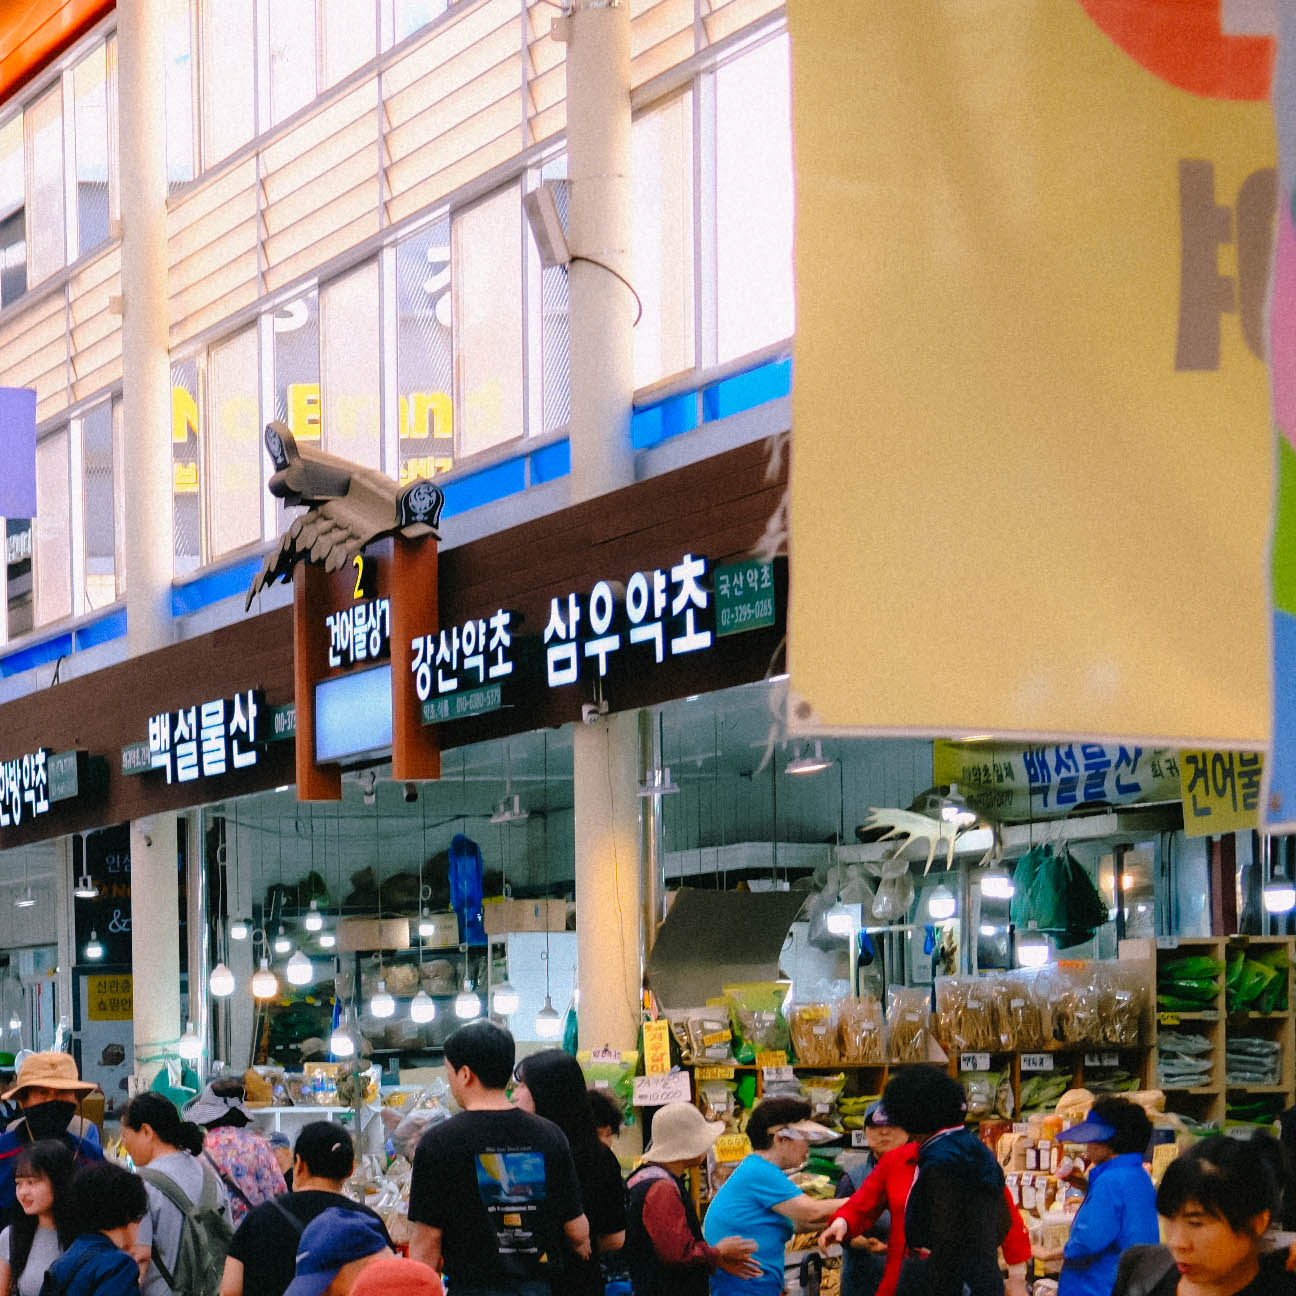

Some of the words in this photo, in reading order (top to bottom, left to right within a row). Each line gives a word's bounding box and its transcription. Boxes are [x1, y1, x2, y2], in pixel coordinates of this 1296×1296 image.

[352, 554, 364, 600] 2
[544, 553, 712, 688] 삼우약초
[411, 608, 513, 700] 강산약초
[148, 689, 258, 785] 백설물산
[1022, 743, 1144, 808] 백설물산
